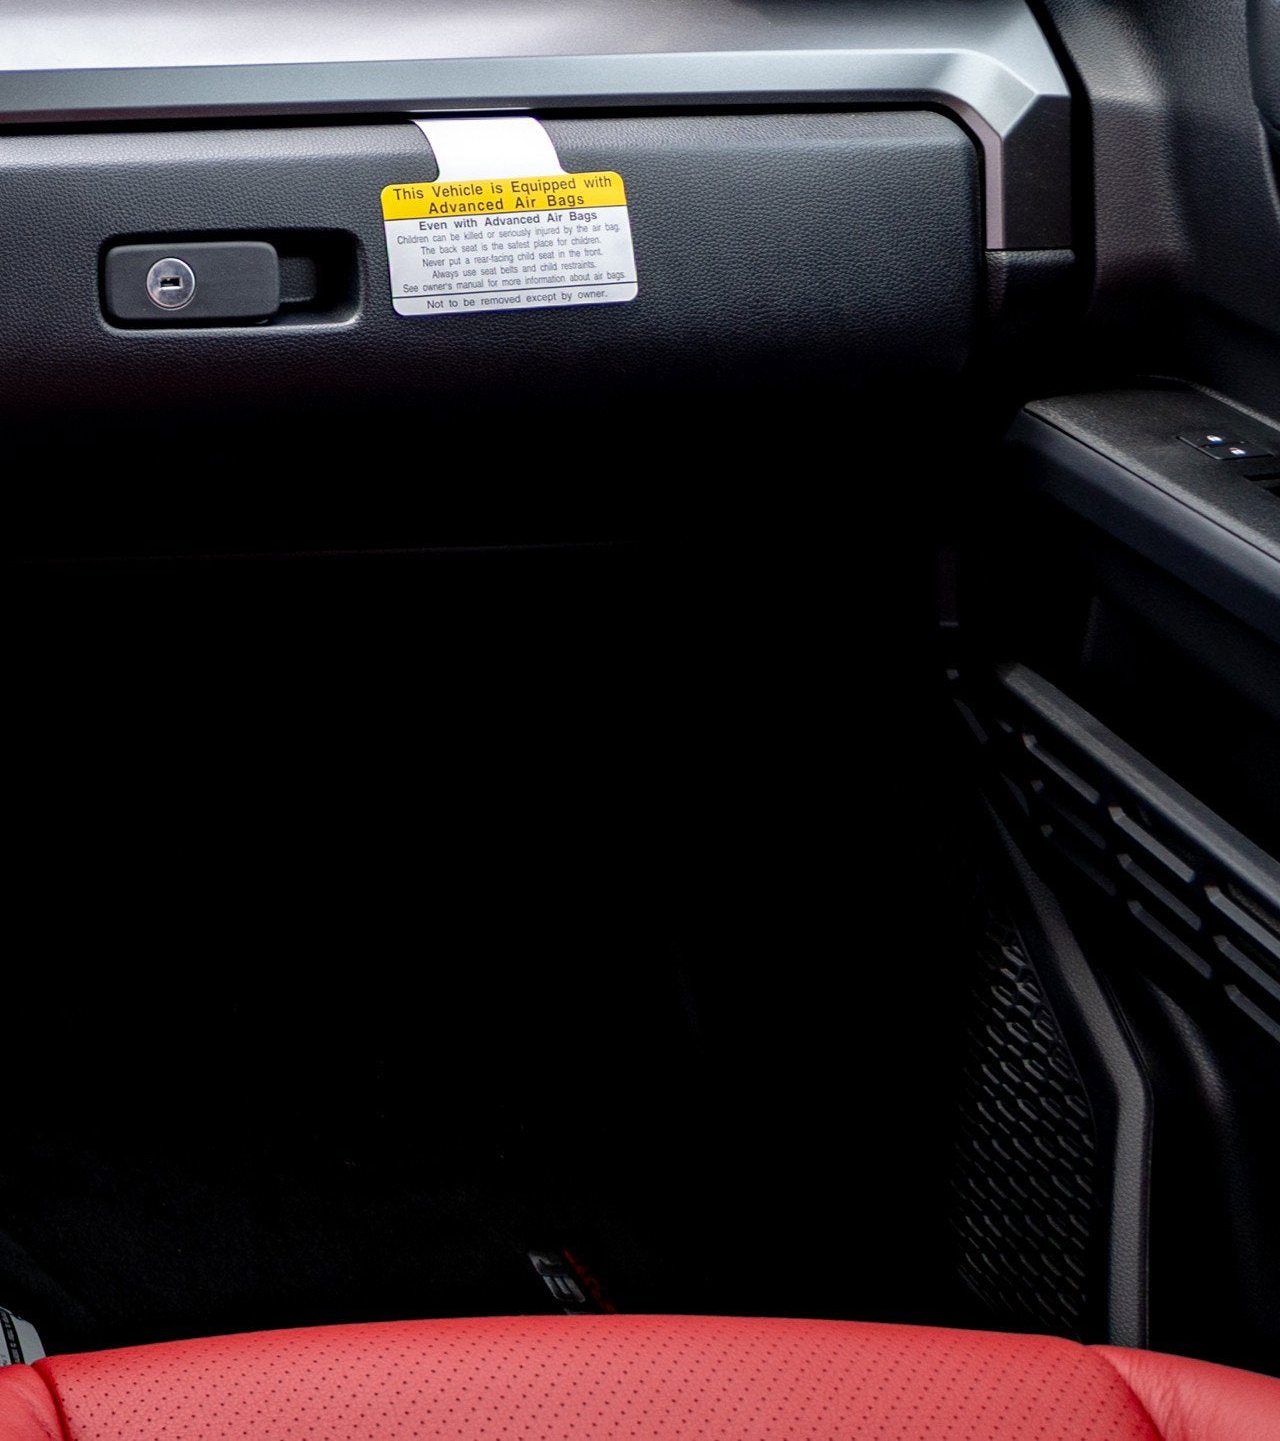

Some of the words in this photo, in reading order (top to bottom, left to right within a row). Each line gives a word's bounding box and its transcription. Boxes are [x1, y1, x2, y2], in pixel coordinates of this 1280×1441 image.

[393, 187, 424, 200] This
[432, 183, 483, 198] Vehicle
[491, 183, 503, 194] is
[511, 178, 576, 194] Equipped
[583, 176, 612, 188] with
[429, 198, 504, 214] Advanced
[515, 197, 536, 208] Air
[547, 195, 584, 207] Bags
[419, 221, 447, 231] Even
[454, 218, 477, 229] with
[485, 214, 540, 227] Advanced
[547, 213, 562, 222] Air
[569, 211, 597, 223] Bags
[397, 235, 429, 245] Children
[433, 234, 446, 242] can
[450, 233, 461, 241] be
[464, 231, 483, 240] killed
[499, 228, 531, 238] seriously
[535, 226, 559, 236] injured
[564, 225, 573, 234] by
[576, 224, 588, 233] the
[593, 224, 601, 232] air
[421, 246, 436, 255] The
[440, 245, 457, 254] back
[462, 244, 477, 253] seat
[492, 242, 504, 250] the
[507, 240, 530, 250] safest
[534, 239, 553, 249] place
[557, 238, 567, 246] for
[427, 299, 444, 310] Not
[448, 299, 459, 308] to
[463, 298, 475, 307] be
[481, 295, 521, 306] removed
[526, 293, 557, 304] except
[561, 292, 573, 302] by
[577, 290, 608, 300] owner.
